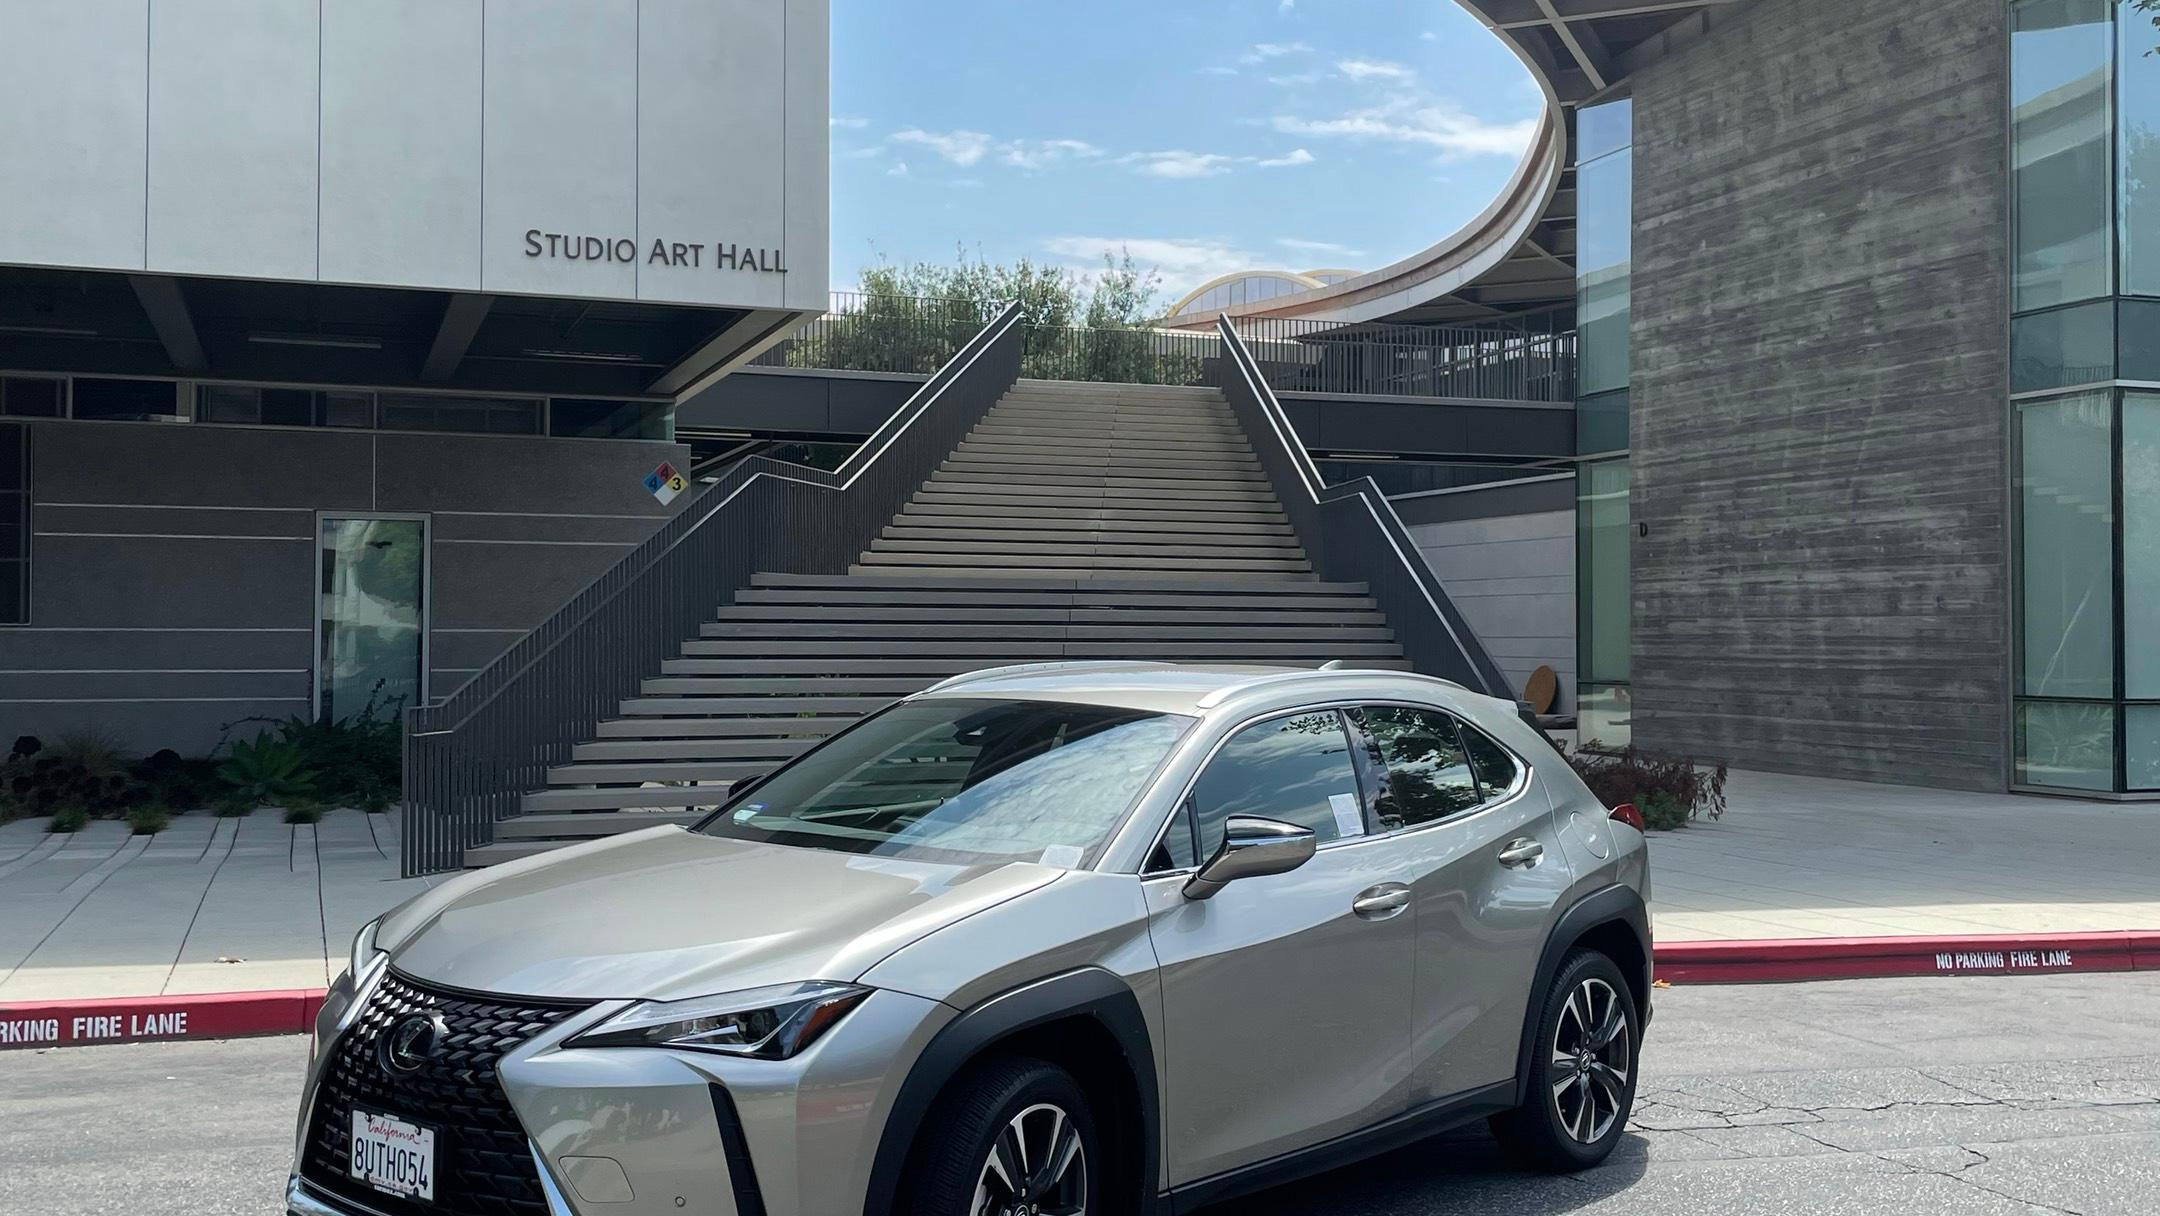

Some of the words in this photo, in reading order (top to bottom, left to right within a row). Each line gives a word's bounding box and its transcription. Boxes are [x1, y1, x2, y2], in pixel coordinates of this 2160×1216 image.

[525, 229, 636, 263] STUDIO
[648, 238, 705, 268] ART
[717, 243, 788, 273] HALL
[648, 476, 658, 491] 4
[672, 477, 682, 491] 3
[660, 465, 669, 481] 4
[1936, 953, 1953, 969] NO
[1956, 951, 2005, 968] PARKING
[2010, 950, 2038, 968] FIRE
[2042, 949, 2073, 967] LANE
[72, 1015, 122, 1039] FIRE
[131, 1012, 188, 1036] LANE
[367, 1118, 420, 1145] California
[354, 1137, 428, 1190] 8UTH054
